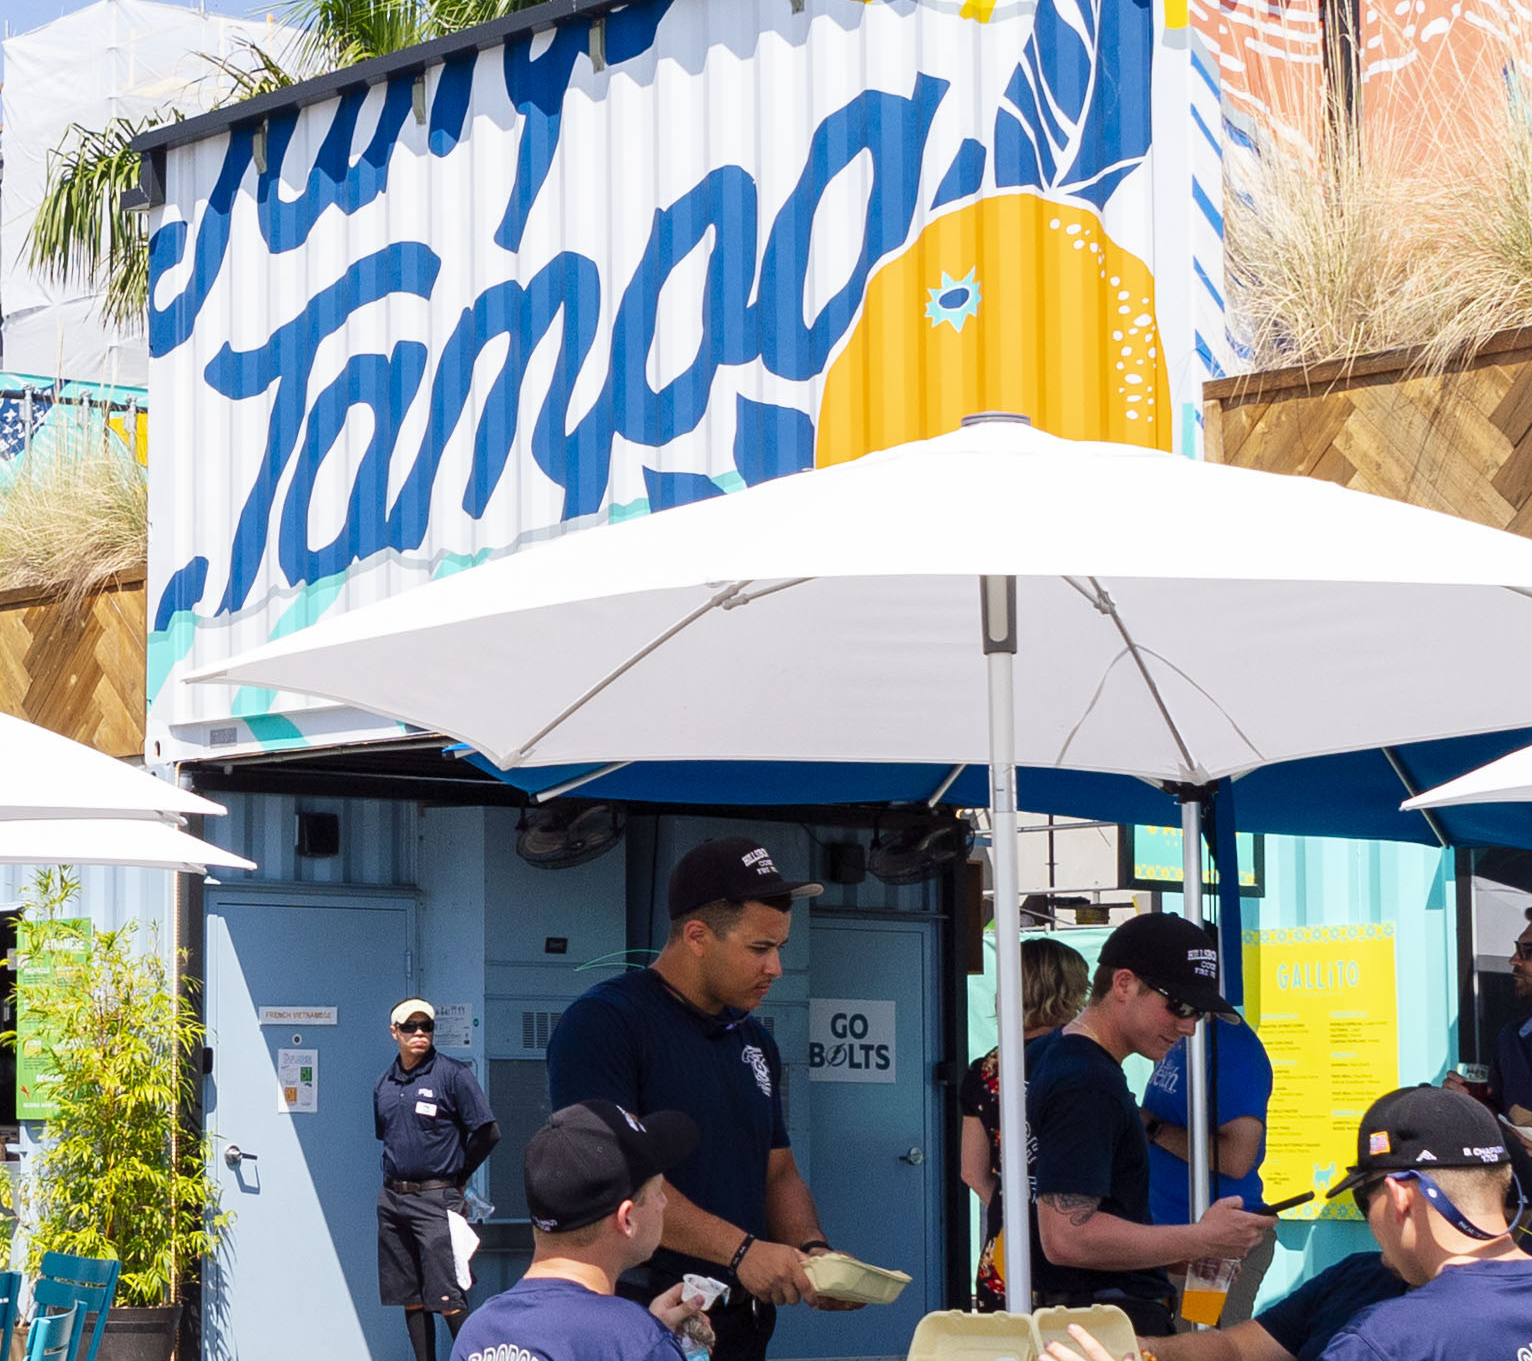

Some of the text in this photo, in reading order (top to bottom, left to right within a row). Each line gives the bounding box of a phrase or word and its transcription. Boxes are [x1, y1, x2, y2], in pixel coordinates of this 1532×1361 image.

[265, 1011, 332, 1019] FRENCH VIETNAMESE
[831, 1012, 869, 1040] GO
